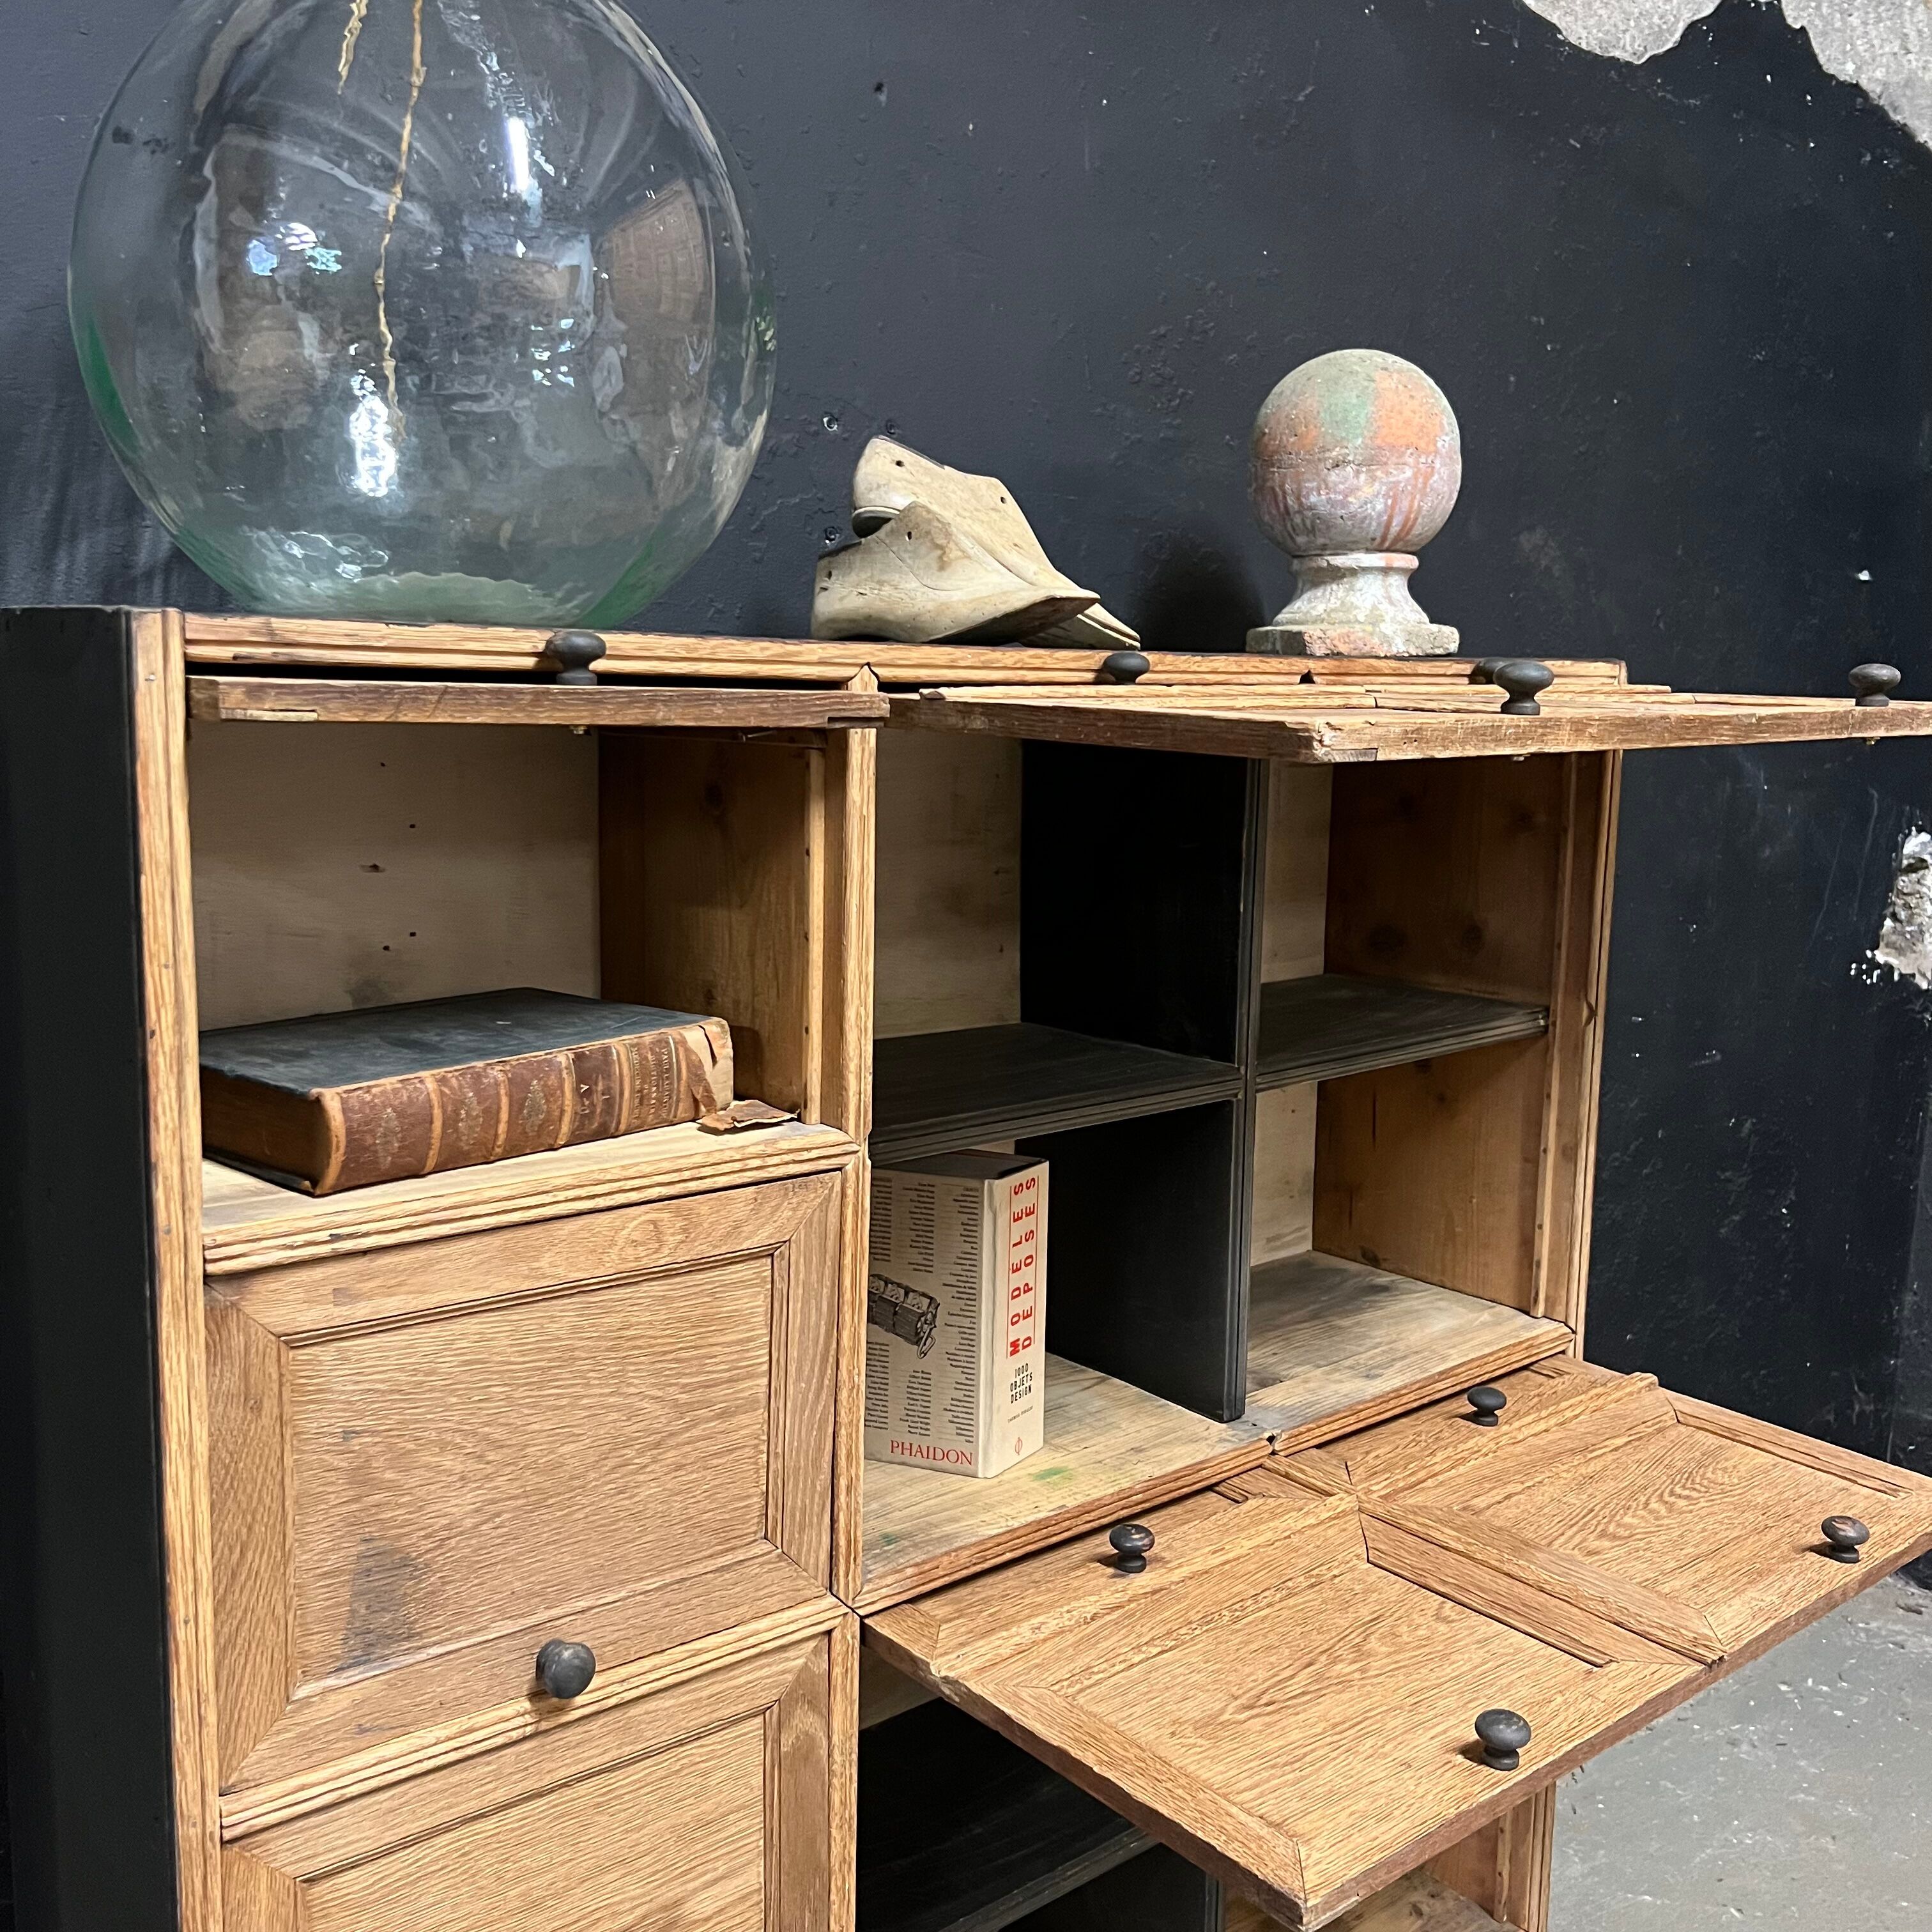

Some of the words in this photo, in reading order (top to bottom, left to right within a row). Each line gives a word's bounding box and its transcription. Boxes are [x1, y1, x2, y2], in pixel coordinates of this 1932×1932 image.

[1015, 1363, 1029, 1379] 1000
[1010, 1372, 1033, 1392] OBJETS
[1011, 1383, 1032, 1404] DESIGN
[890, 1439, 973, 1466] PHAIDON
